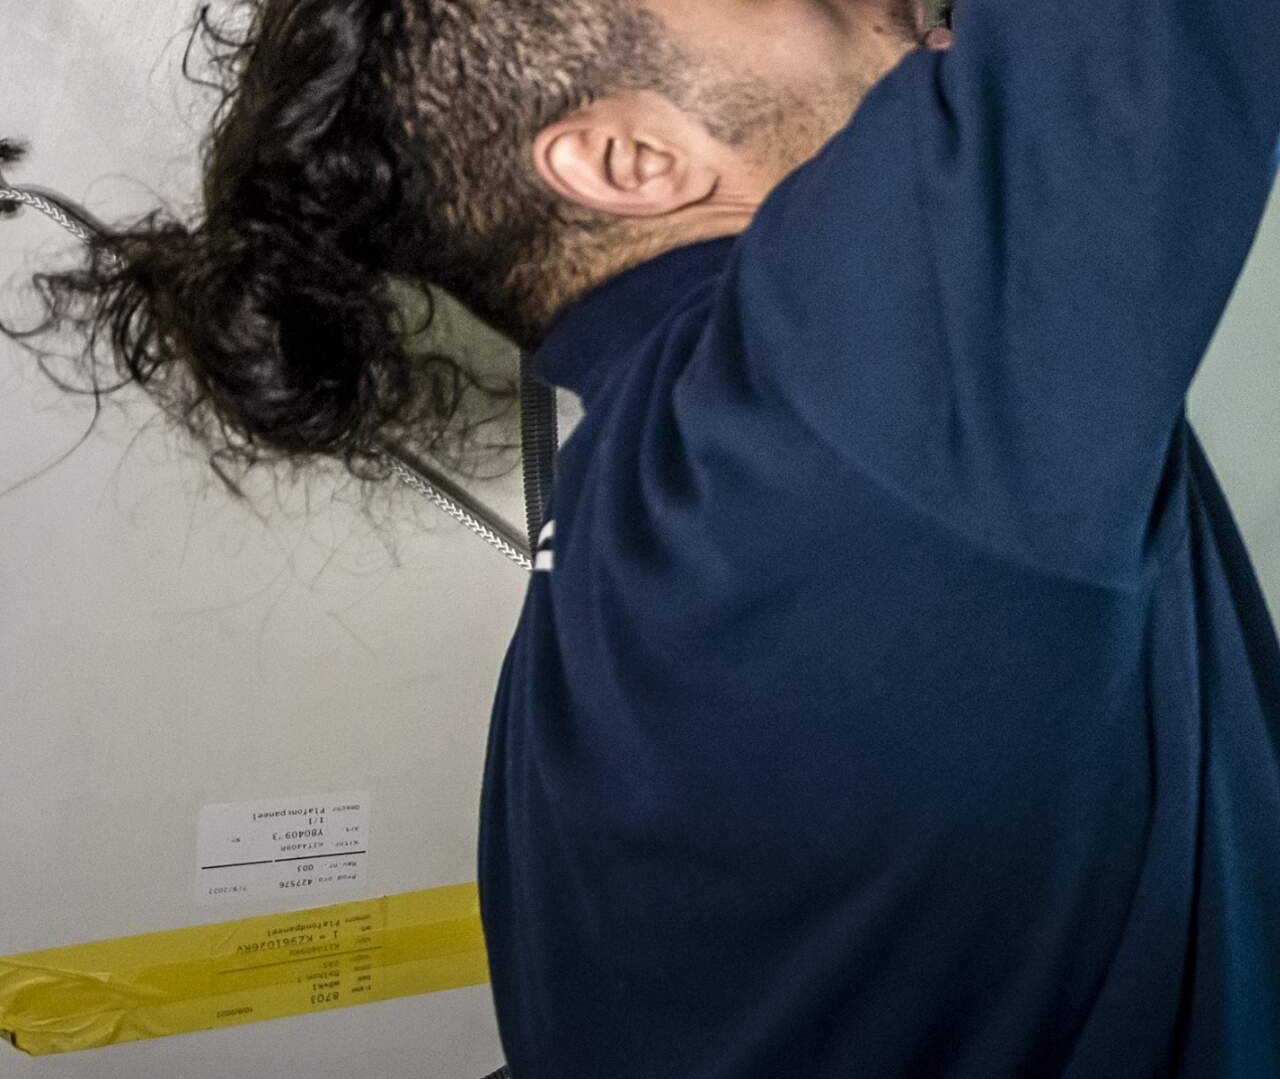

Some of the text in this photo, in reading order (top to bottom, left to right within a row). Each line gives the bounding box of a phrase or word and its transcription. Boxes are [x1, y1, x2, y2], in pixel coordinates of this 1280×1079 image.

[297, 864, 314, 872] 003
[279, 879, 313, 888] 427576
[311, 991, 340, 1005] 8703
